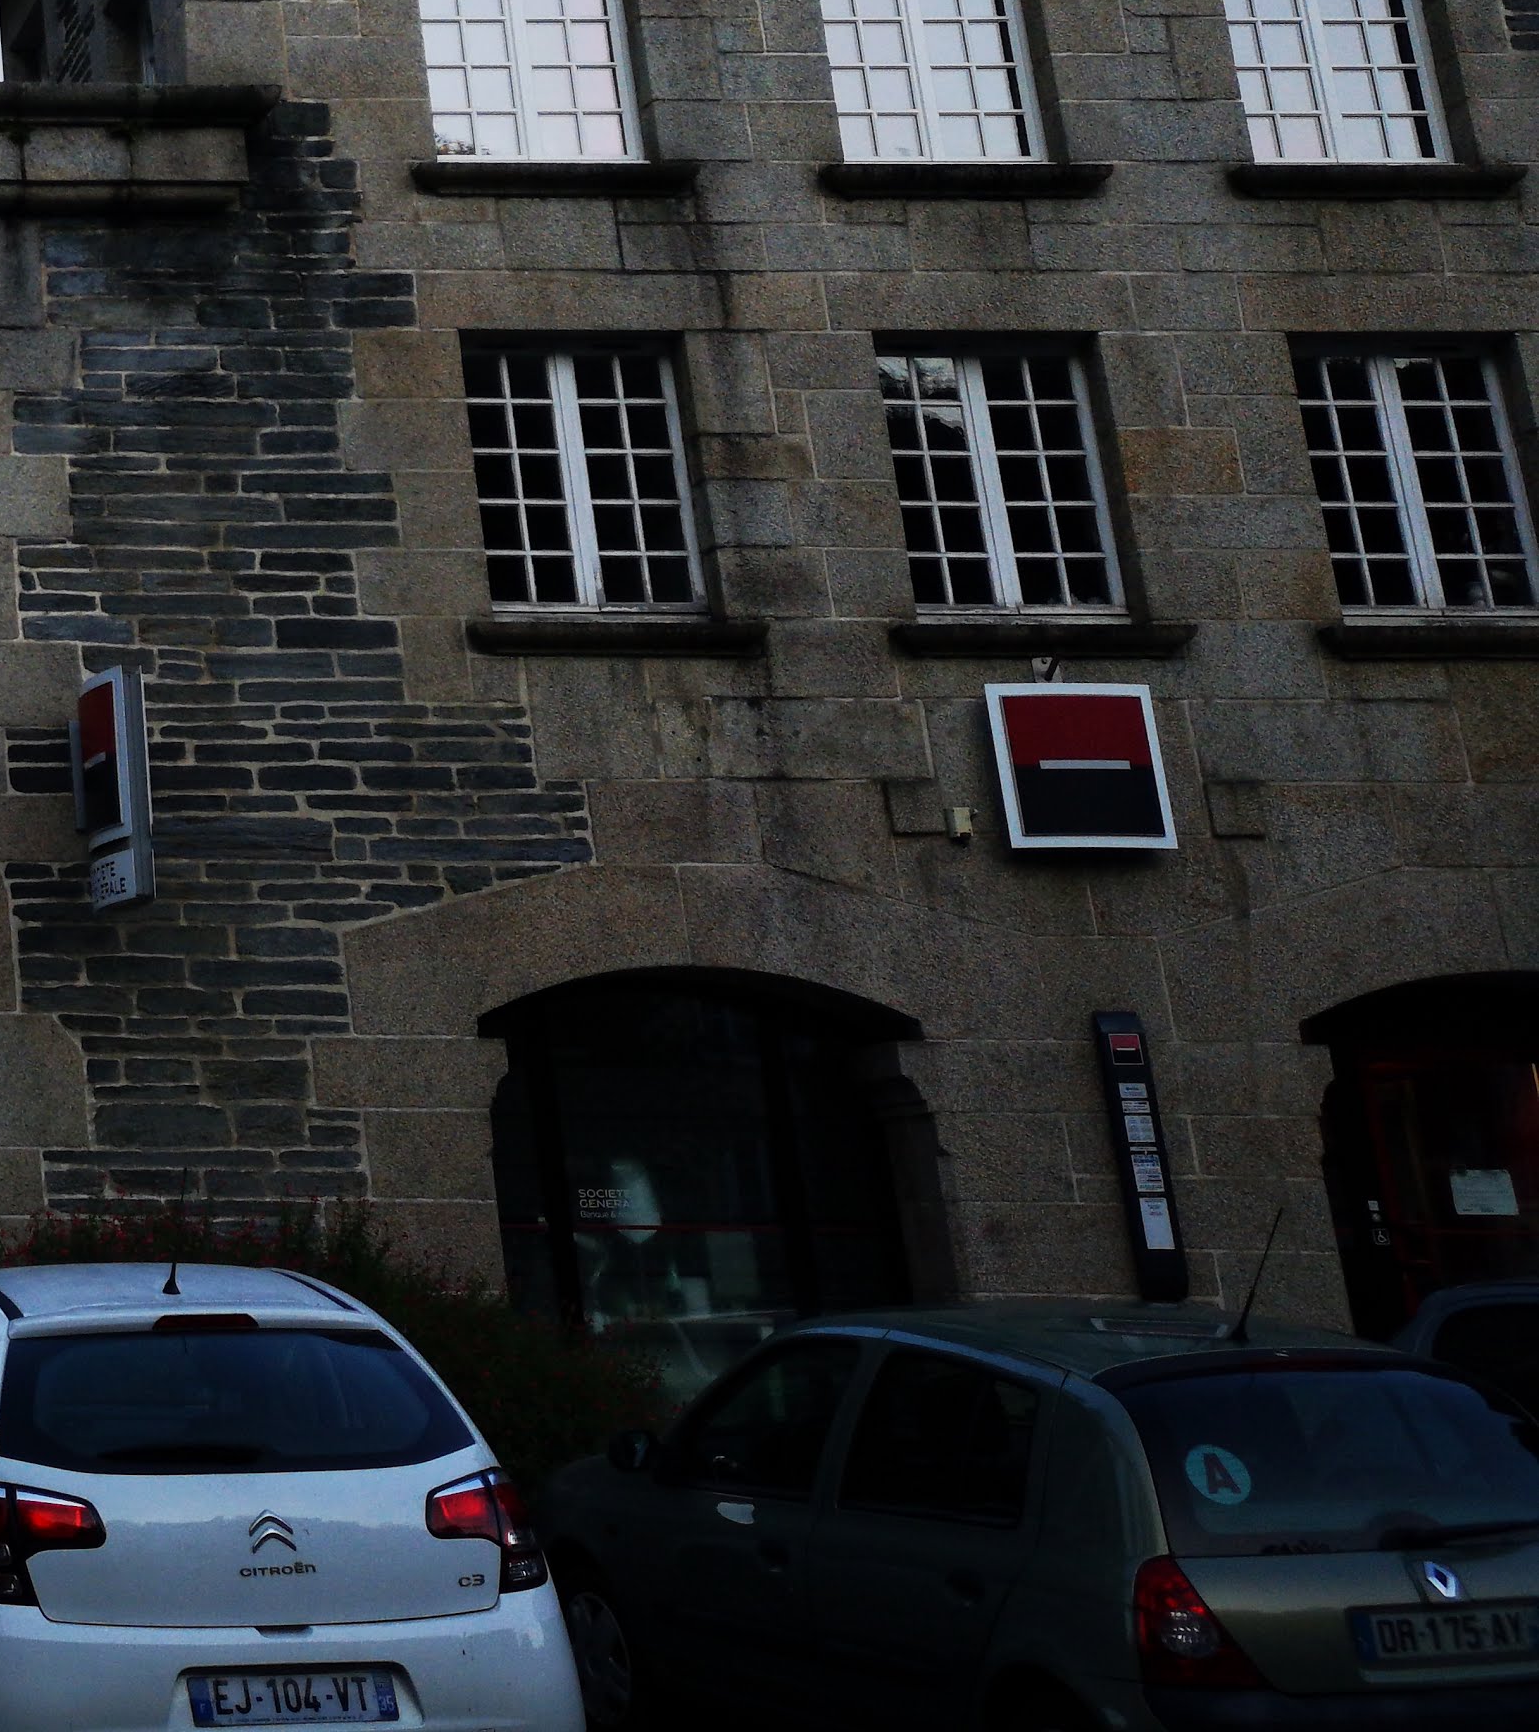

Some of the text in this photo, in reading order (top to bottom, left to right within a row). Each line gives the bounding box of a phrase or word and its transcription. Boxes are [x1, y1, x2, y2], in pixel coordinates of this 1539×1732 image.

[1203, 1452, 1242, 1495] A
[458, 1574, 485, 1587] C3
[1375, 1612, 1521, 1653] DR-175-AY
[212, 1676, 368, 1716] EJ-104-VT
